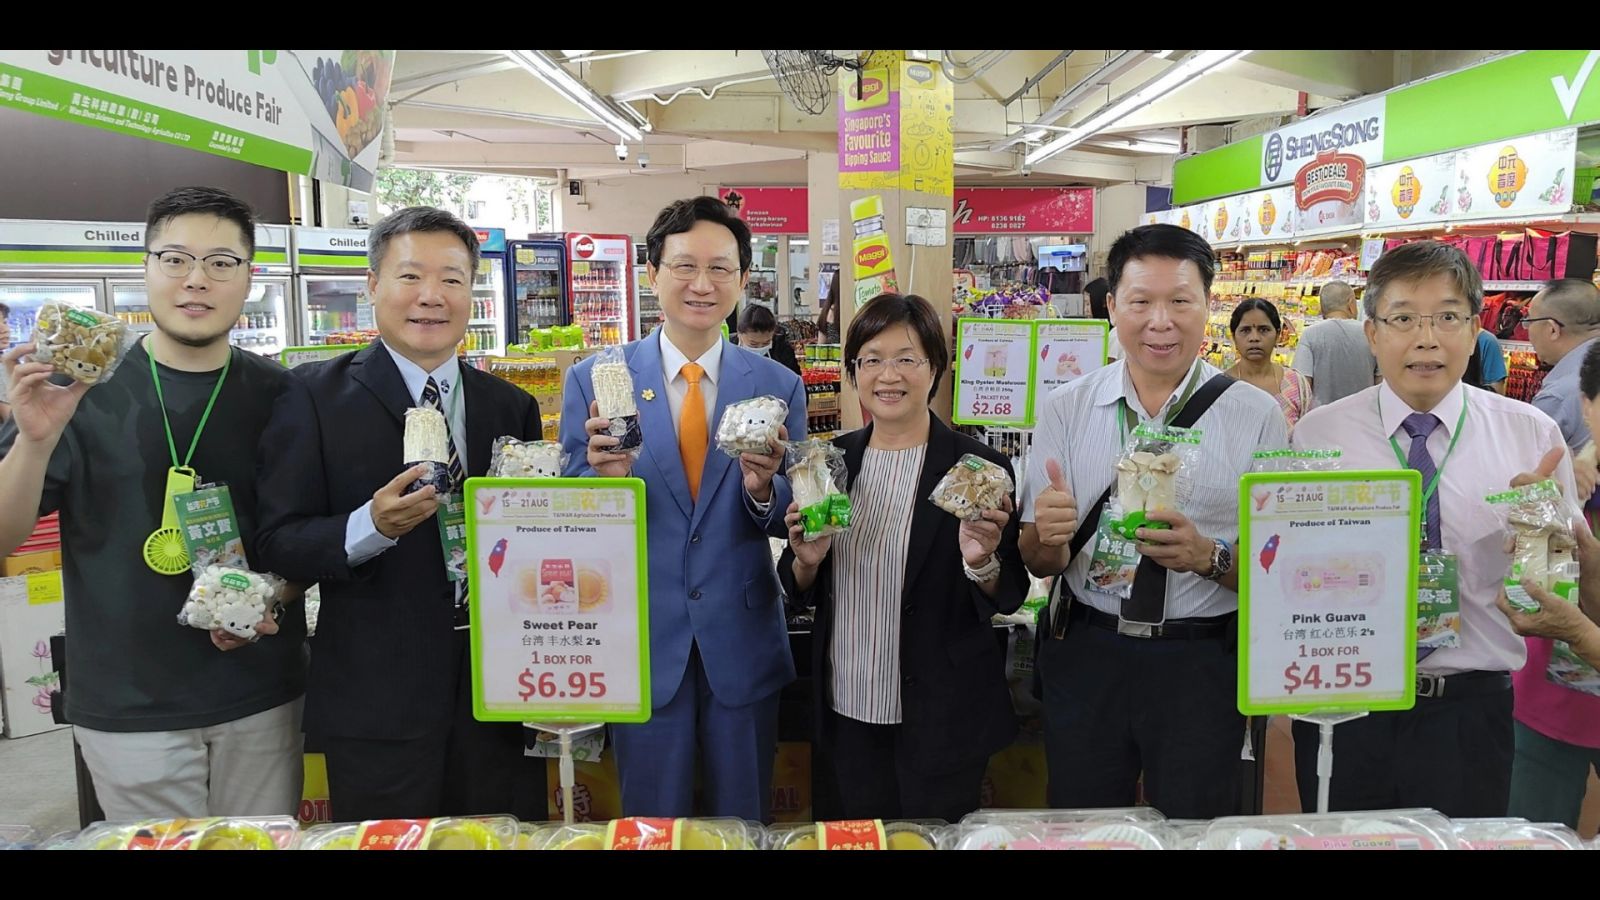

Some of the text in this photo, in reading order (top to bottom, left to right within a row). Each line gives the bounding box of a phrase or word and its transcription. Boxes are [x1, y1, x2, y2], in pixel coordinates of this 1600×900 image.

[184, 64, 252, 116] Produce
[256, 91, 282, 126] Fair
[844, 113, 891, 132] Singapore's
[844, 131, 892, 152] Favourite
[844, 151, 892, 168] Dipping Sauce
[1306, 164, 1346, 186] BEST DEALS
[84, 230, 140, 242] Chilled
[329, 238, 366, 248] Chilled
[859, 249, 885, 263] Maggi
[858, 282, 881, 298] Tomato
[972, 401, 1012, 416] $2.68
[1290, 520, 1325, 528] Produce
[523, 620, 598, 630] Sweet Pear
[1292, 612, 1366, 624] Pink Guava
[1283, 626, 1375, 640] 台湾 红心芭乐 2's
[522, 635, 601, 646] 台湾 丰水梨 2's
[531, 651, 592, 664] 1 BOX FOR
[1298, 644, 1360, 657] 1 BOX FOR
[518, 668, 607, 702] $6.95
[1284, 661, 1372, 695] $4.55
[1322, 839, 1392, 849] Pink Guava
